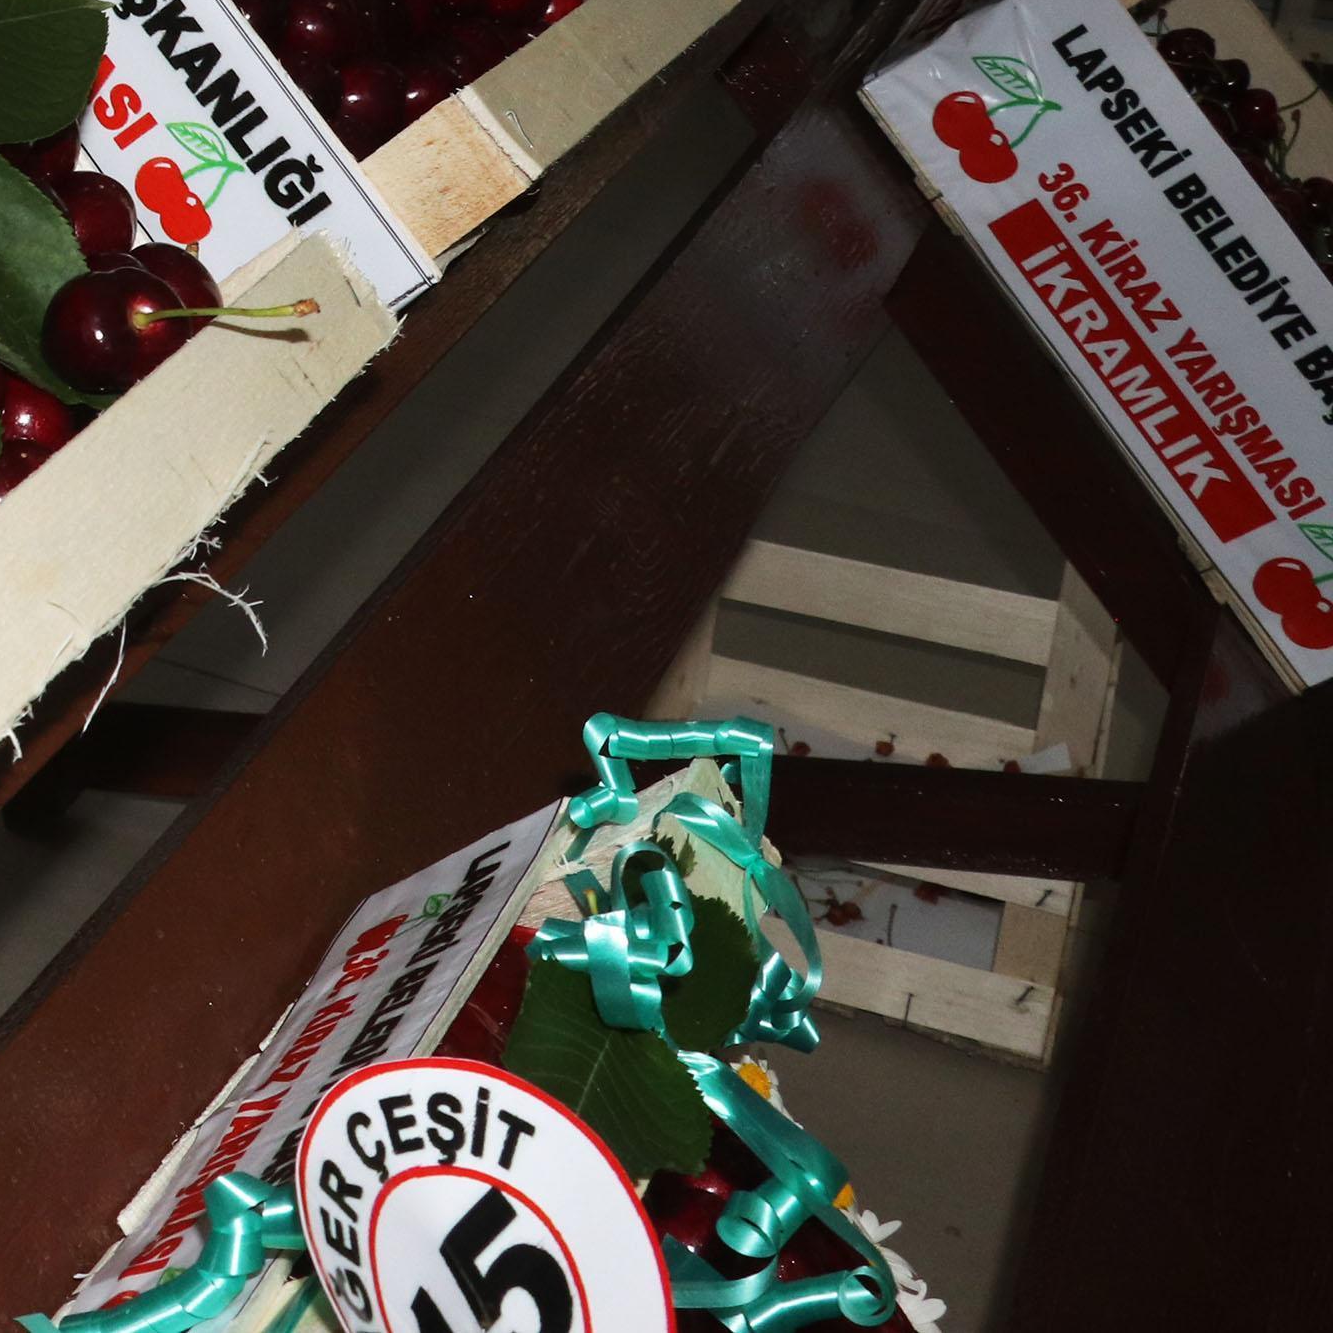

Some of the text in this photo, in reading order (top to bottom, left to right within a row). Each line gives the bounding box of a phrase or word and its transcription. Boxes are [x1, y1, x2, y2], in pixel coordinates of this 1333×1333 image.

[1051, 23, 1192, 179] LAPSEKİ
[1163, 172, 1317, 351] BELEDİYE
[1020, 242, 1232, 500] İKRAMLIK
[1038, 162, 1327, 522] 36. KİRAZ YARIŞMASI
[405, 840, 512, 968] LAPSEKİ
[253, 993, 359, 1092] KİRAZ
[326, 948, 390, 1000] 36.
[346, 1086, 536, 1184] ÇEŞİT
[410, 1185, 574, 1333] 15
